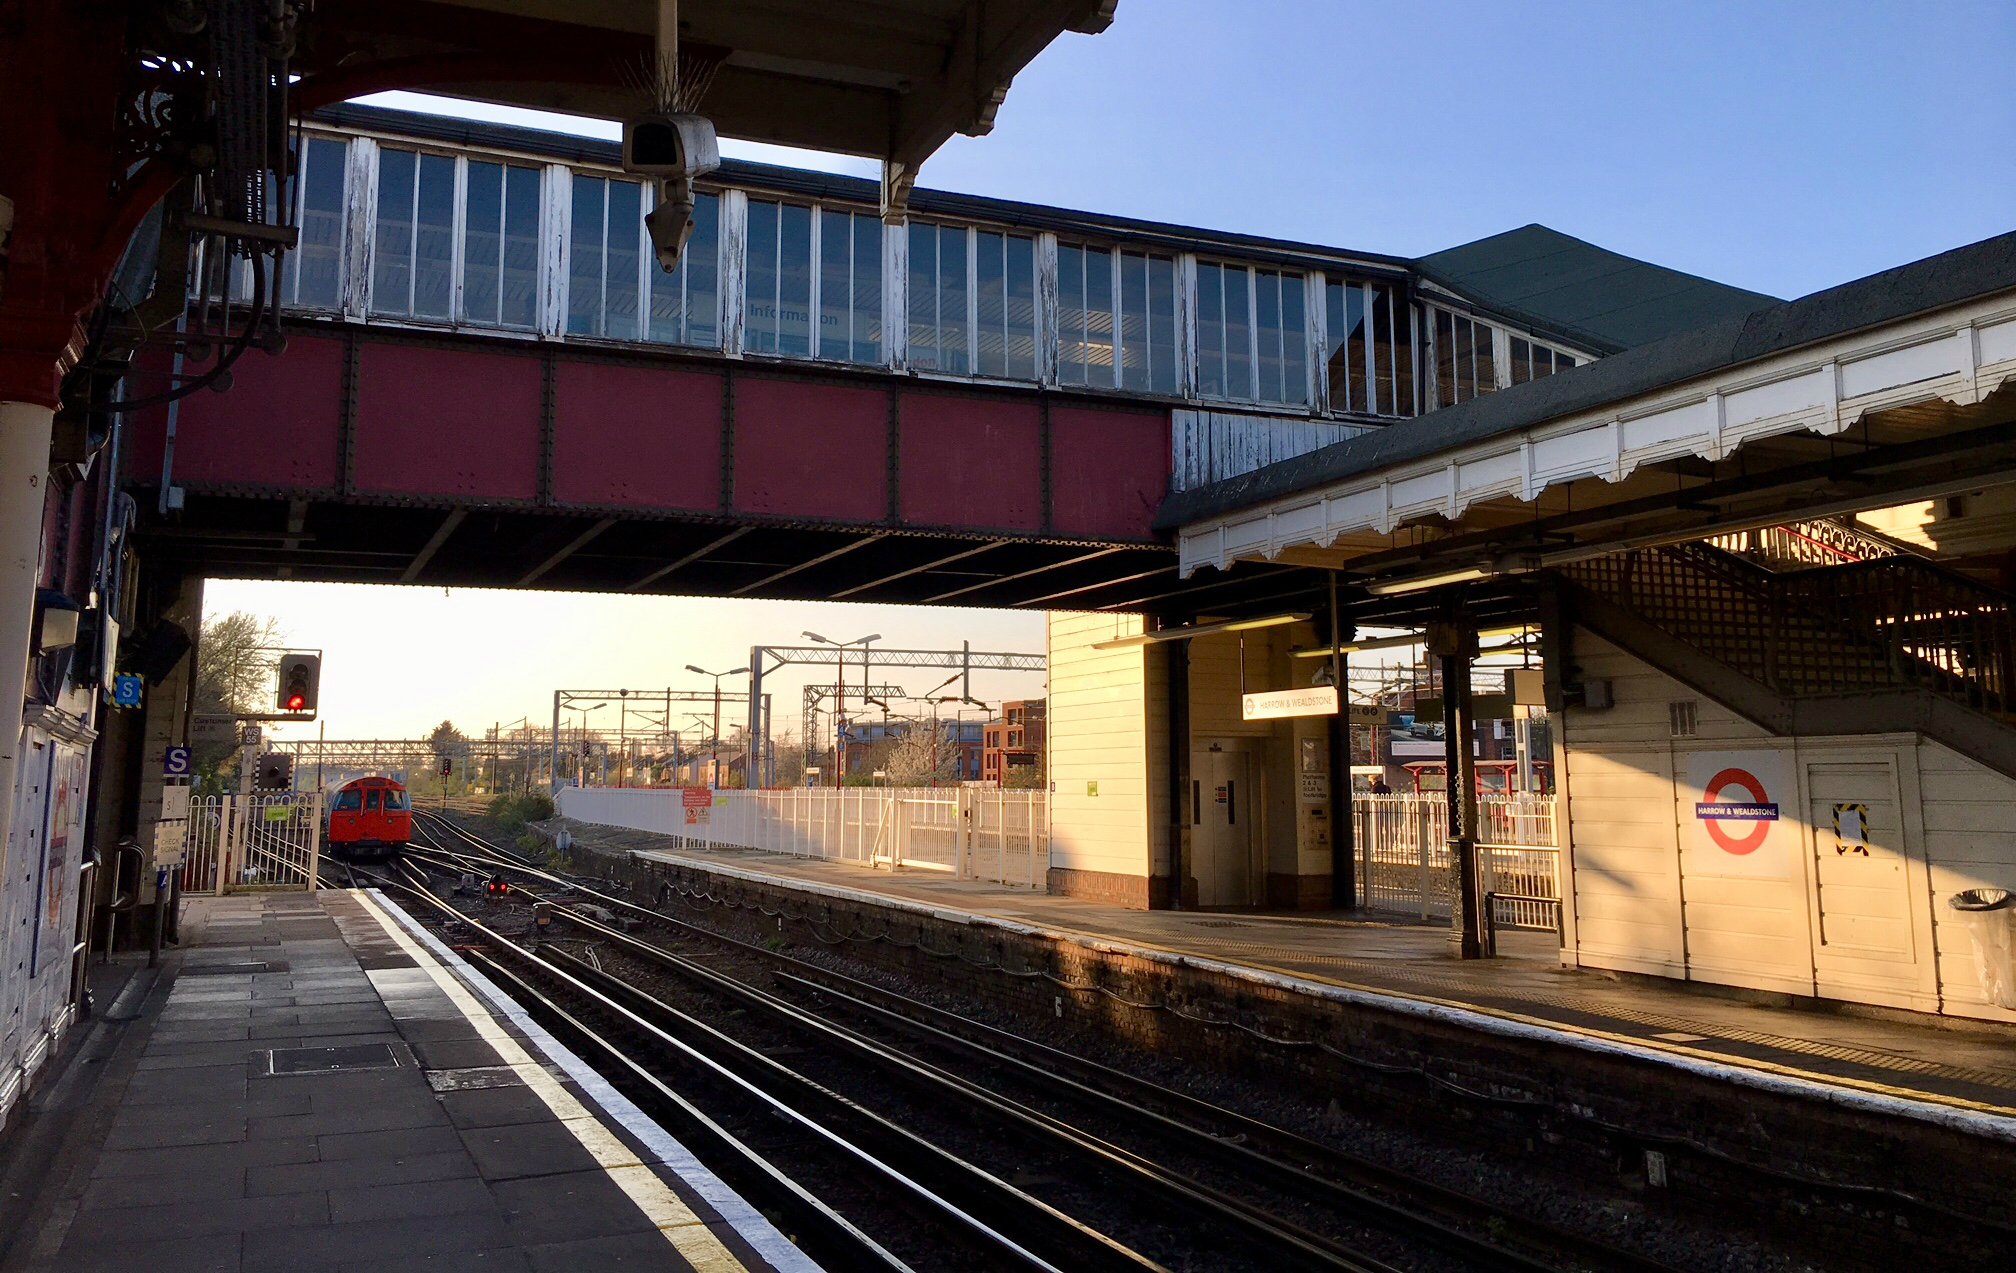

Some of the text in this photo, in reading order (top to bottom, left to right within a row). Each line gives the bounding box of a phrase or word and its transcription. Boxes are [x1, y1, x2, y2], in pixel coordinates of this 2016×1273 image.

[750, 303, 838, 326] Informaon
[123, 682, 133, 698] S
[1259, 696, 1332, 710] HARROW & WEALDSTONE
[194, 717, 231, 725] Customer
[244, 728, 260, 736] WS
[245, 736, 257, 744] 55
[168, 749, 188, 772] S
[1726, 808, 1732, 816] &
[1733, 808, 1776, 816] WEALDSTONE
[161, 838, 180, 846] CHECK
[160, 846, 179, 854] SIGNAL
